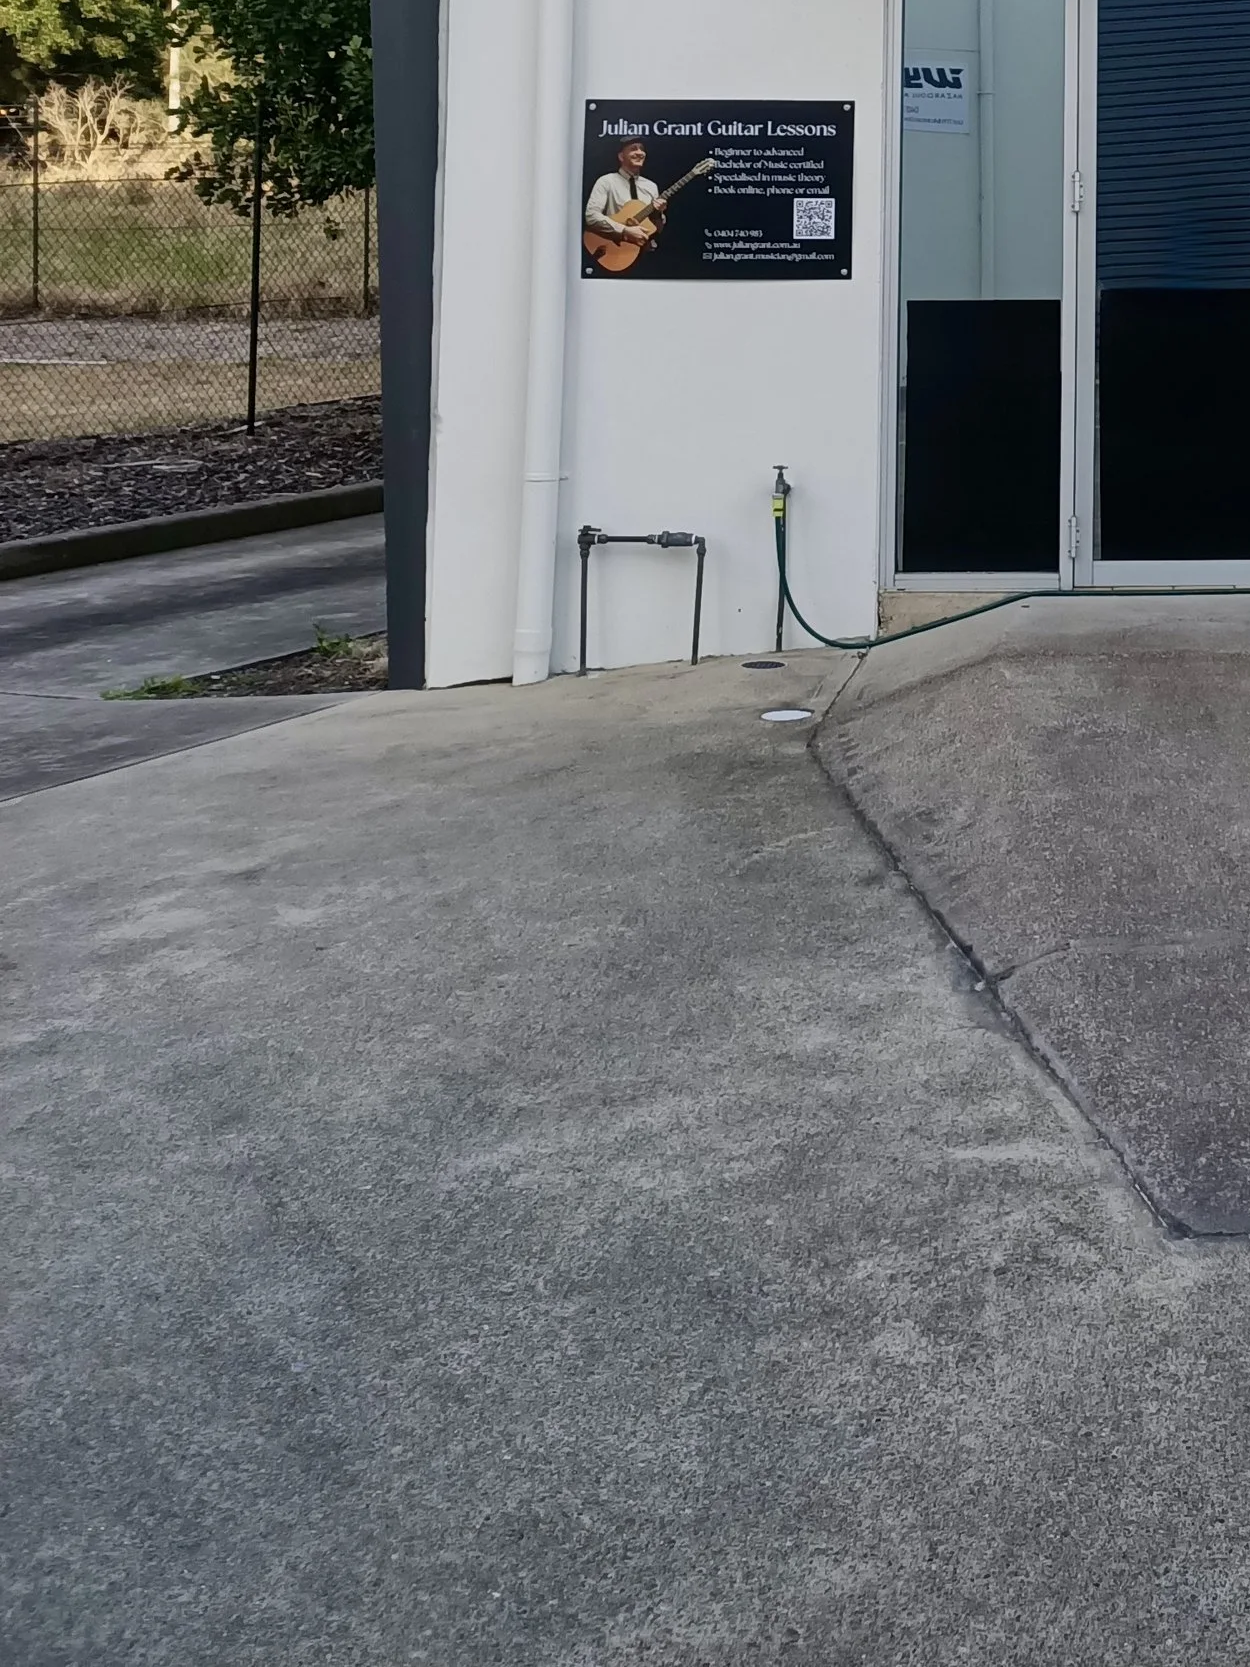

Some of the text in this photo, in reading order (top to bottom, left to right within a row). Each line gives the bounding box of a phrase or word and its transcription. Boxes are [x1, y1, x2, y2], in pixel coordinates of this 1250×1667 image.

[599, 119, 837, 137] Julian Grant Guitar Lessons
[714, 147, 804, 158] Beginner to advanced
[714, 160, 824, 169] Bachelor of Music certified
[714, 173, 826, 183] Specialised in music theory
[714, 185, 830, 197] Book online, phone or email
